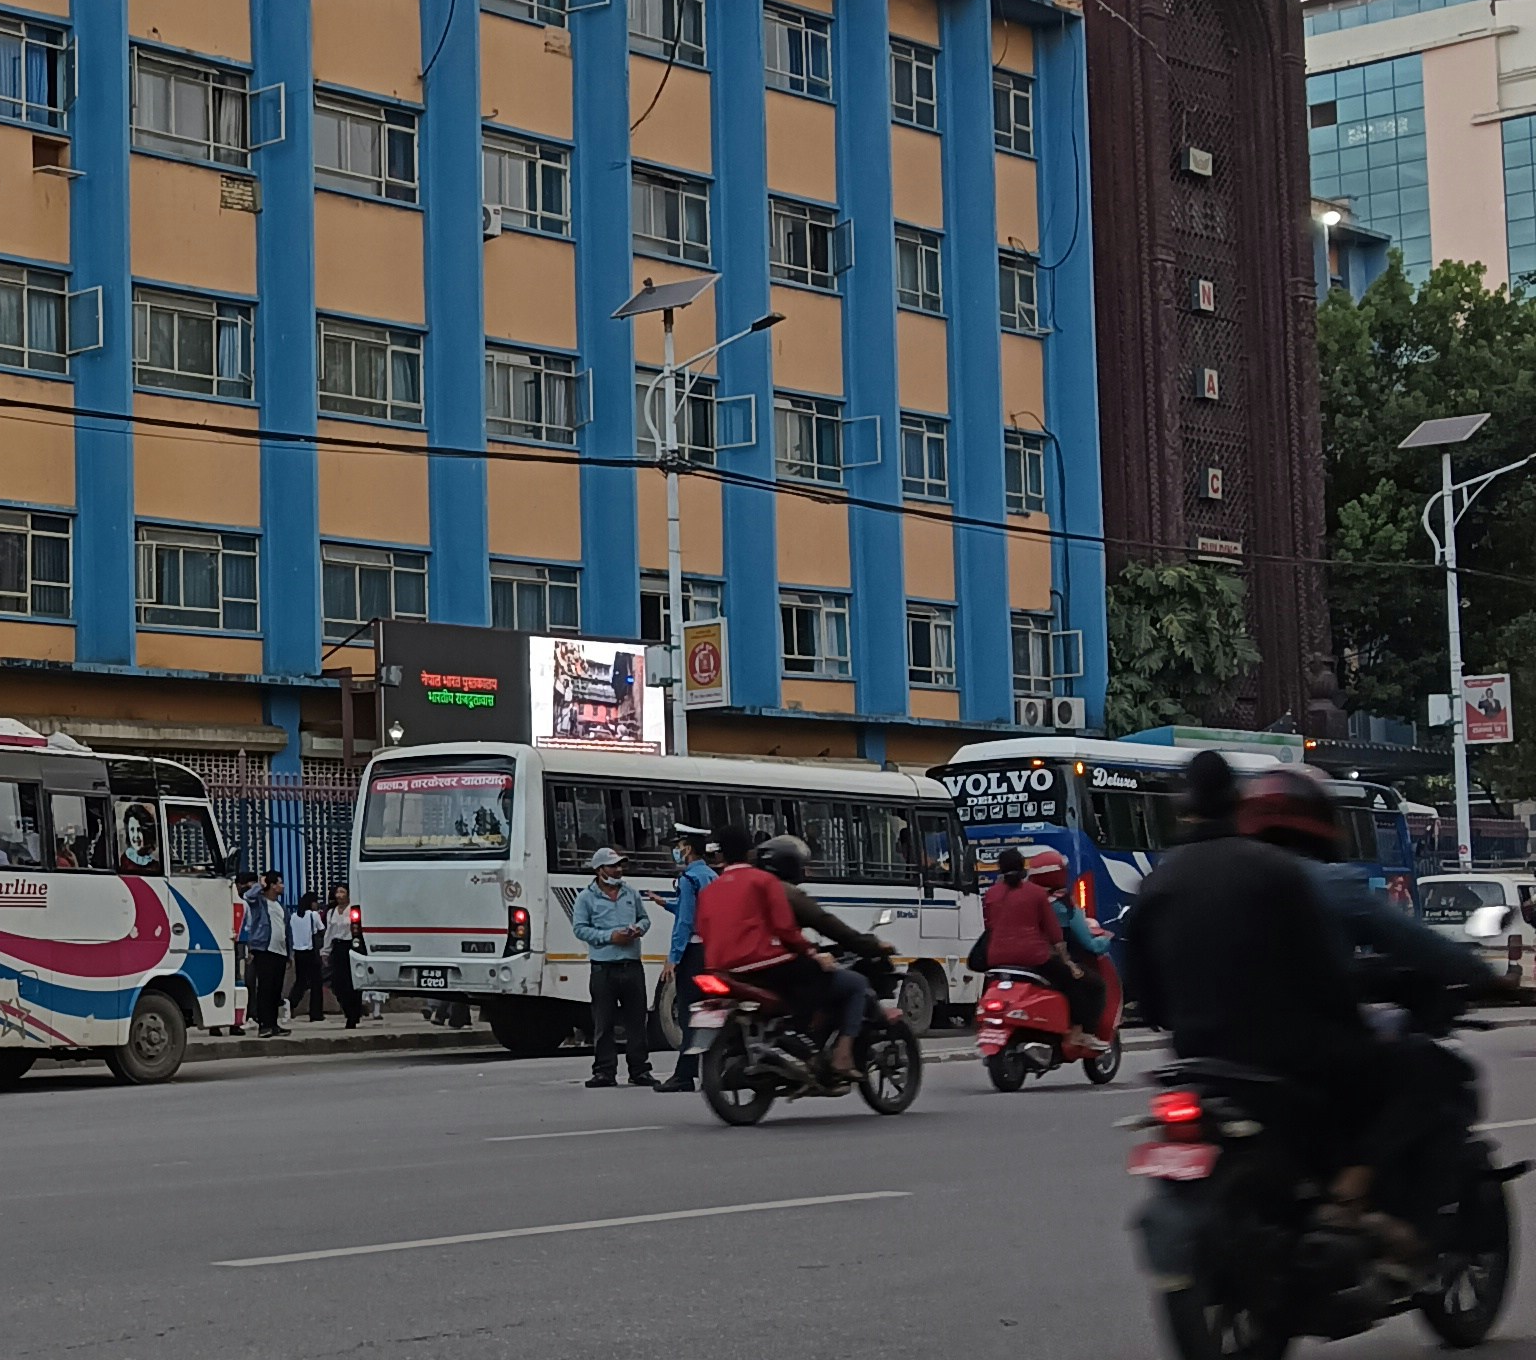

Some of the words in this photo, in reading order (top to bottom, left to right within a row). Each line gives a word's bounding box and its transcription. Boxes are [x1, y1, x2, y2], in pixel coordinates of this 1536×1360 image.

[1201, 284, 1212, 306] N
[1207, 373, 1216, 395] A
[1210, 473, 1220, 494] C
[943, 769, 1054, 797] VOLVO
[1092, 767, 1138, 789] Deluxe
[966, 793, 1029, 806] DELUXE
